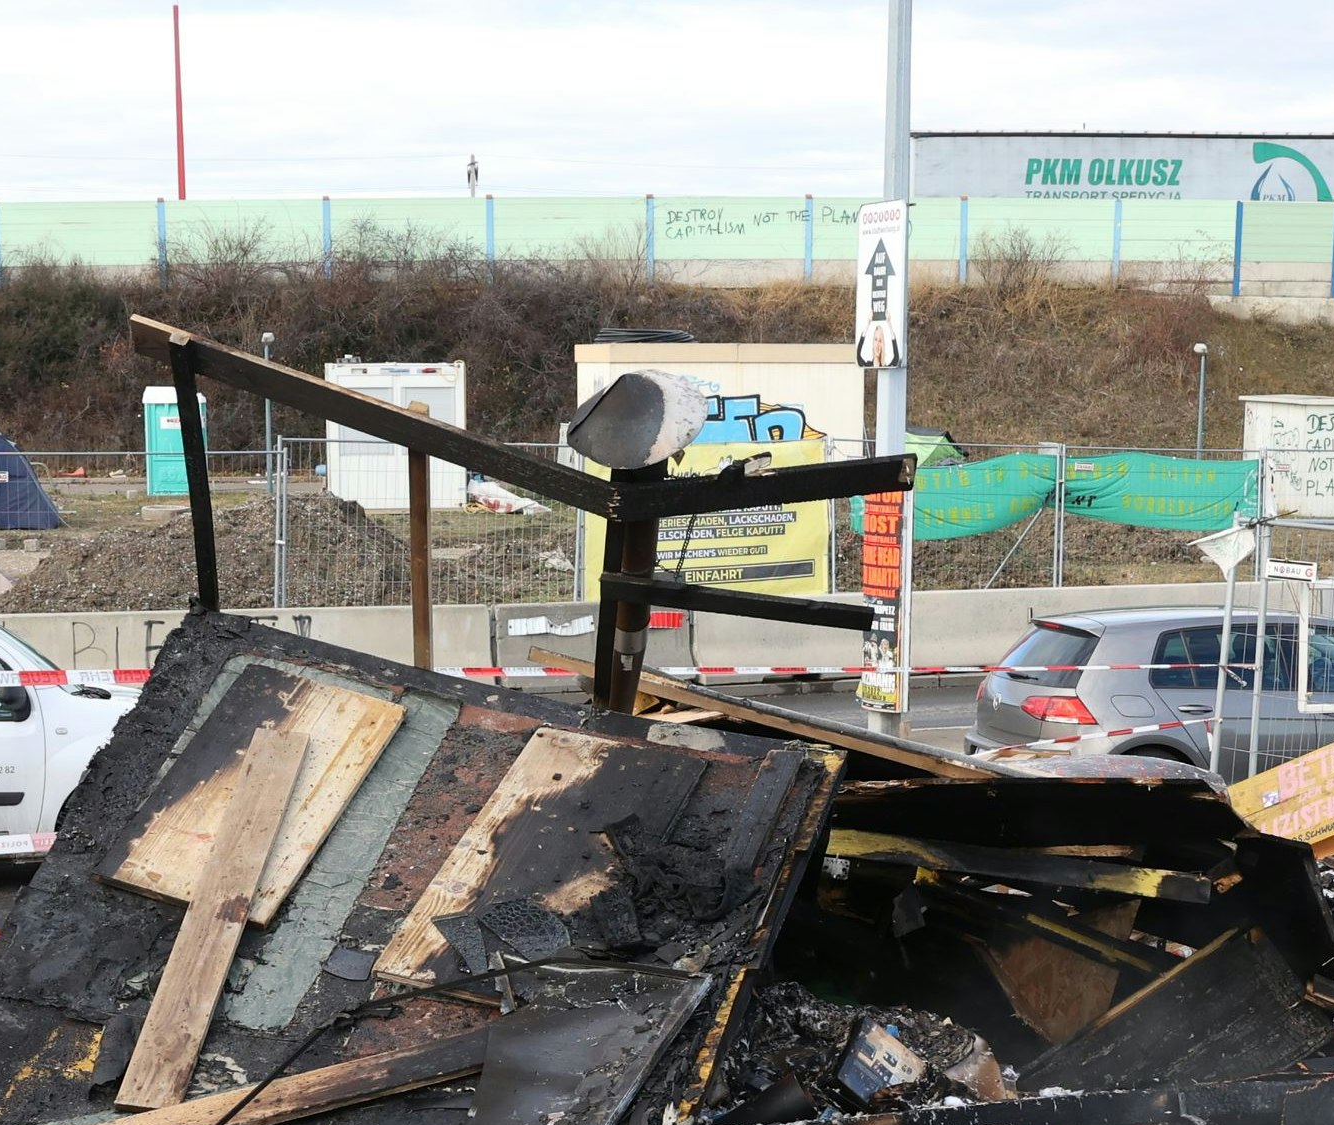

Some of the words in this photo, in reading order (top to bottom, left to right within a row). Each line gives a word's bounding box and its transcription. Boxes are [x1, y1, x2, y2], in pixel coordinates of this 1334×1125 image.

[1025, 158, 1082, 186] PKM
[1088, 158, 1183, 187] OLKUSZ
[666, 208, 724, 226] DESTROY
[753, 213, 779, 226] NOT
[787, 210, 811, 222] THE
[665, 222, 746, 240] CAPITALISM
[729, 513, 795, 526] LACKSCHADEN,
[716, 527, 744, 538] FELGE
[746, 524, 784, 537] KAPUTT?
[717, 547, 748, 557] WIEDER
[684, 568, 744, 582] EINFAHRT
[4, 766, 15, 774] 82
